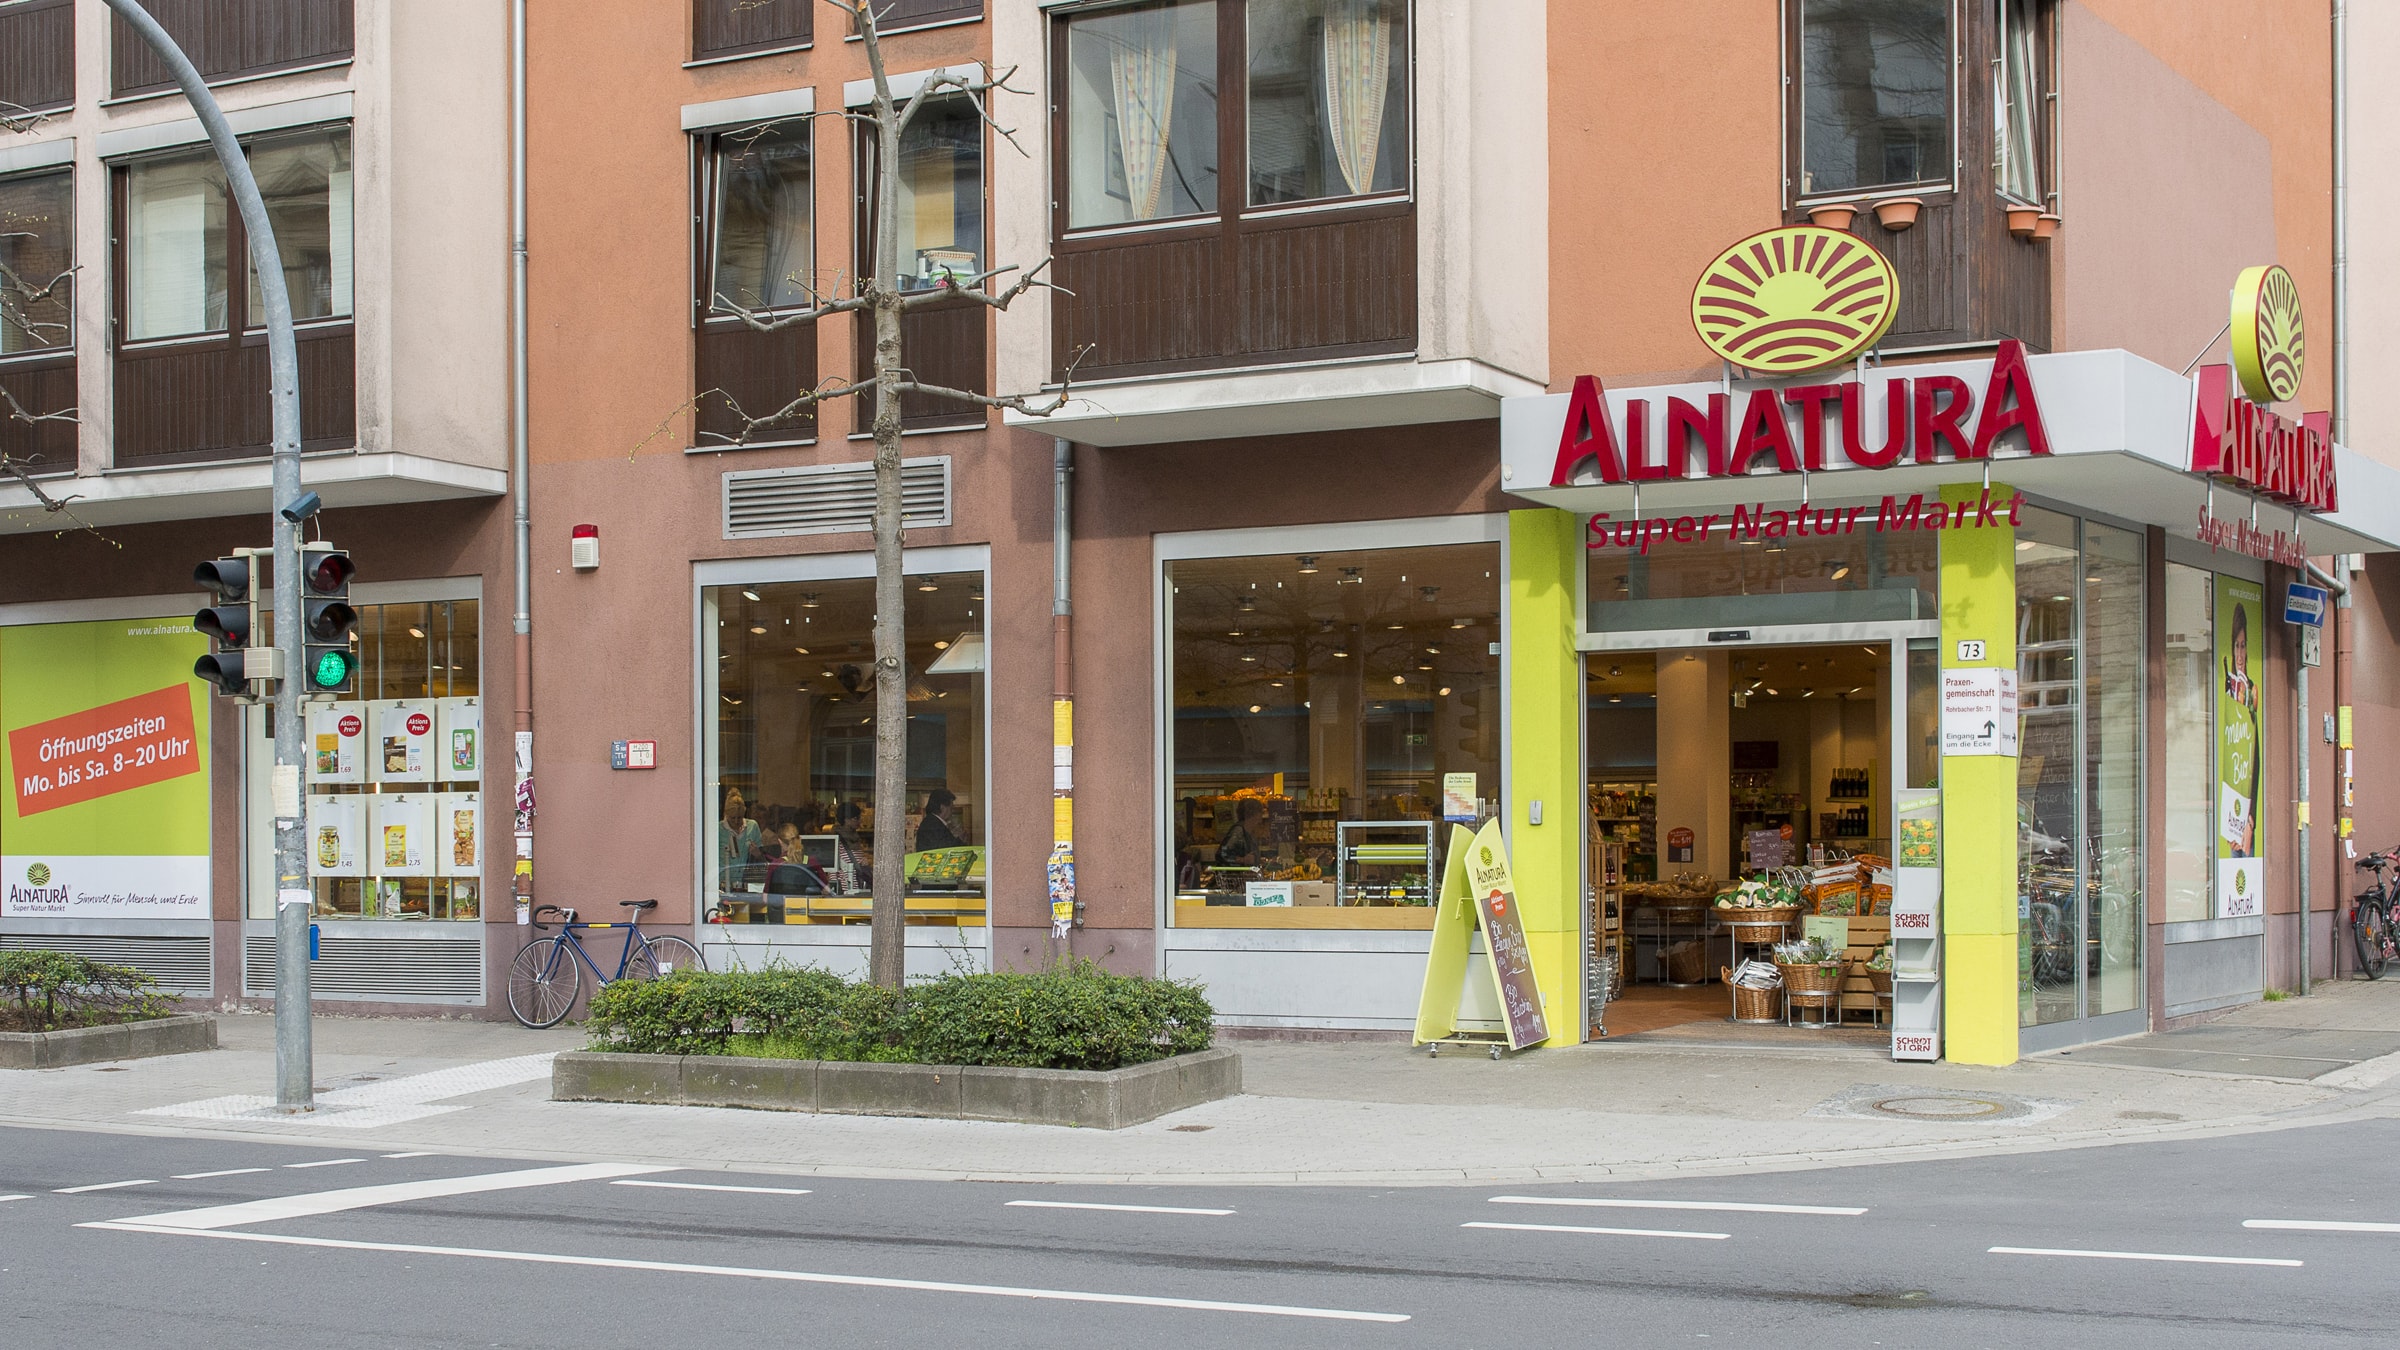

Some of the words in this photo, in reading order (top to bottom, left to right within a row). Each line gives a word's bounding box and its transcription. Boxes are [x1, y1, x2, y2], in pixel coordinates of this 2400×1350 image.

[1550, 339, 2054, 487] ALNATURA
[2191, 364, 2338, 512] ALNATURA
[1586, 511, 1720, 556] Super
[1729, 503, 1866, 541] Natur
[1876, 489, 2027, 534] Markt
[2197, 505, 2234, 554] Super
[2236, 518, 2271, 560] Natur
[1963, 643, 1980, 658] 73
[1945, 678, 1974, 687] Praxen-
[1946, 688, 1995, 700] gemeinschaft
[1976, 705, 1984, 713] Str.
[408, 718, 428, 726] Aktions
[2225, 706, 2251, 746] mein
[39, 715, 166, 763] Öffnungszeiten
[23, 774, 54, 797] Mo.
[58, 764, 81, 788] bis
[86, 760, 109, 781] Sa.
[158, 737, 190, 761] Uhr
[2231, 742, 2252, 785] Bio!
[408, 859, 421, 867] 2,75
[1476, 862, 1507, 884] ALNATURA
[10, 884, 69, 903] ALNATURA
[74, 892, 110, 905] Sinnvoll
[110, 894, 124, 905] für
[125, 892, 158, 906] Mensch
[160, 894, 177, 904] und
[178, 894, 198, 905] Erde
[13, 904, 29, 912] Super
[48, 904, 66, 912] Markt
[2227, 892, 2254, 916] ALNATURA
[1895, 913, 1930, 921] SCHROT
[1895, 920, 1901, 928] &
[1902, 920, 1930, 928] KORN
[1896, 1037, 1932, 1045] SCHROT
